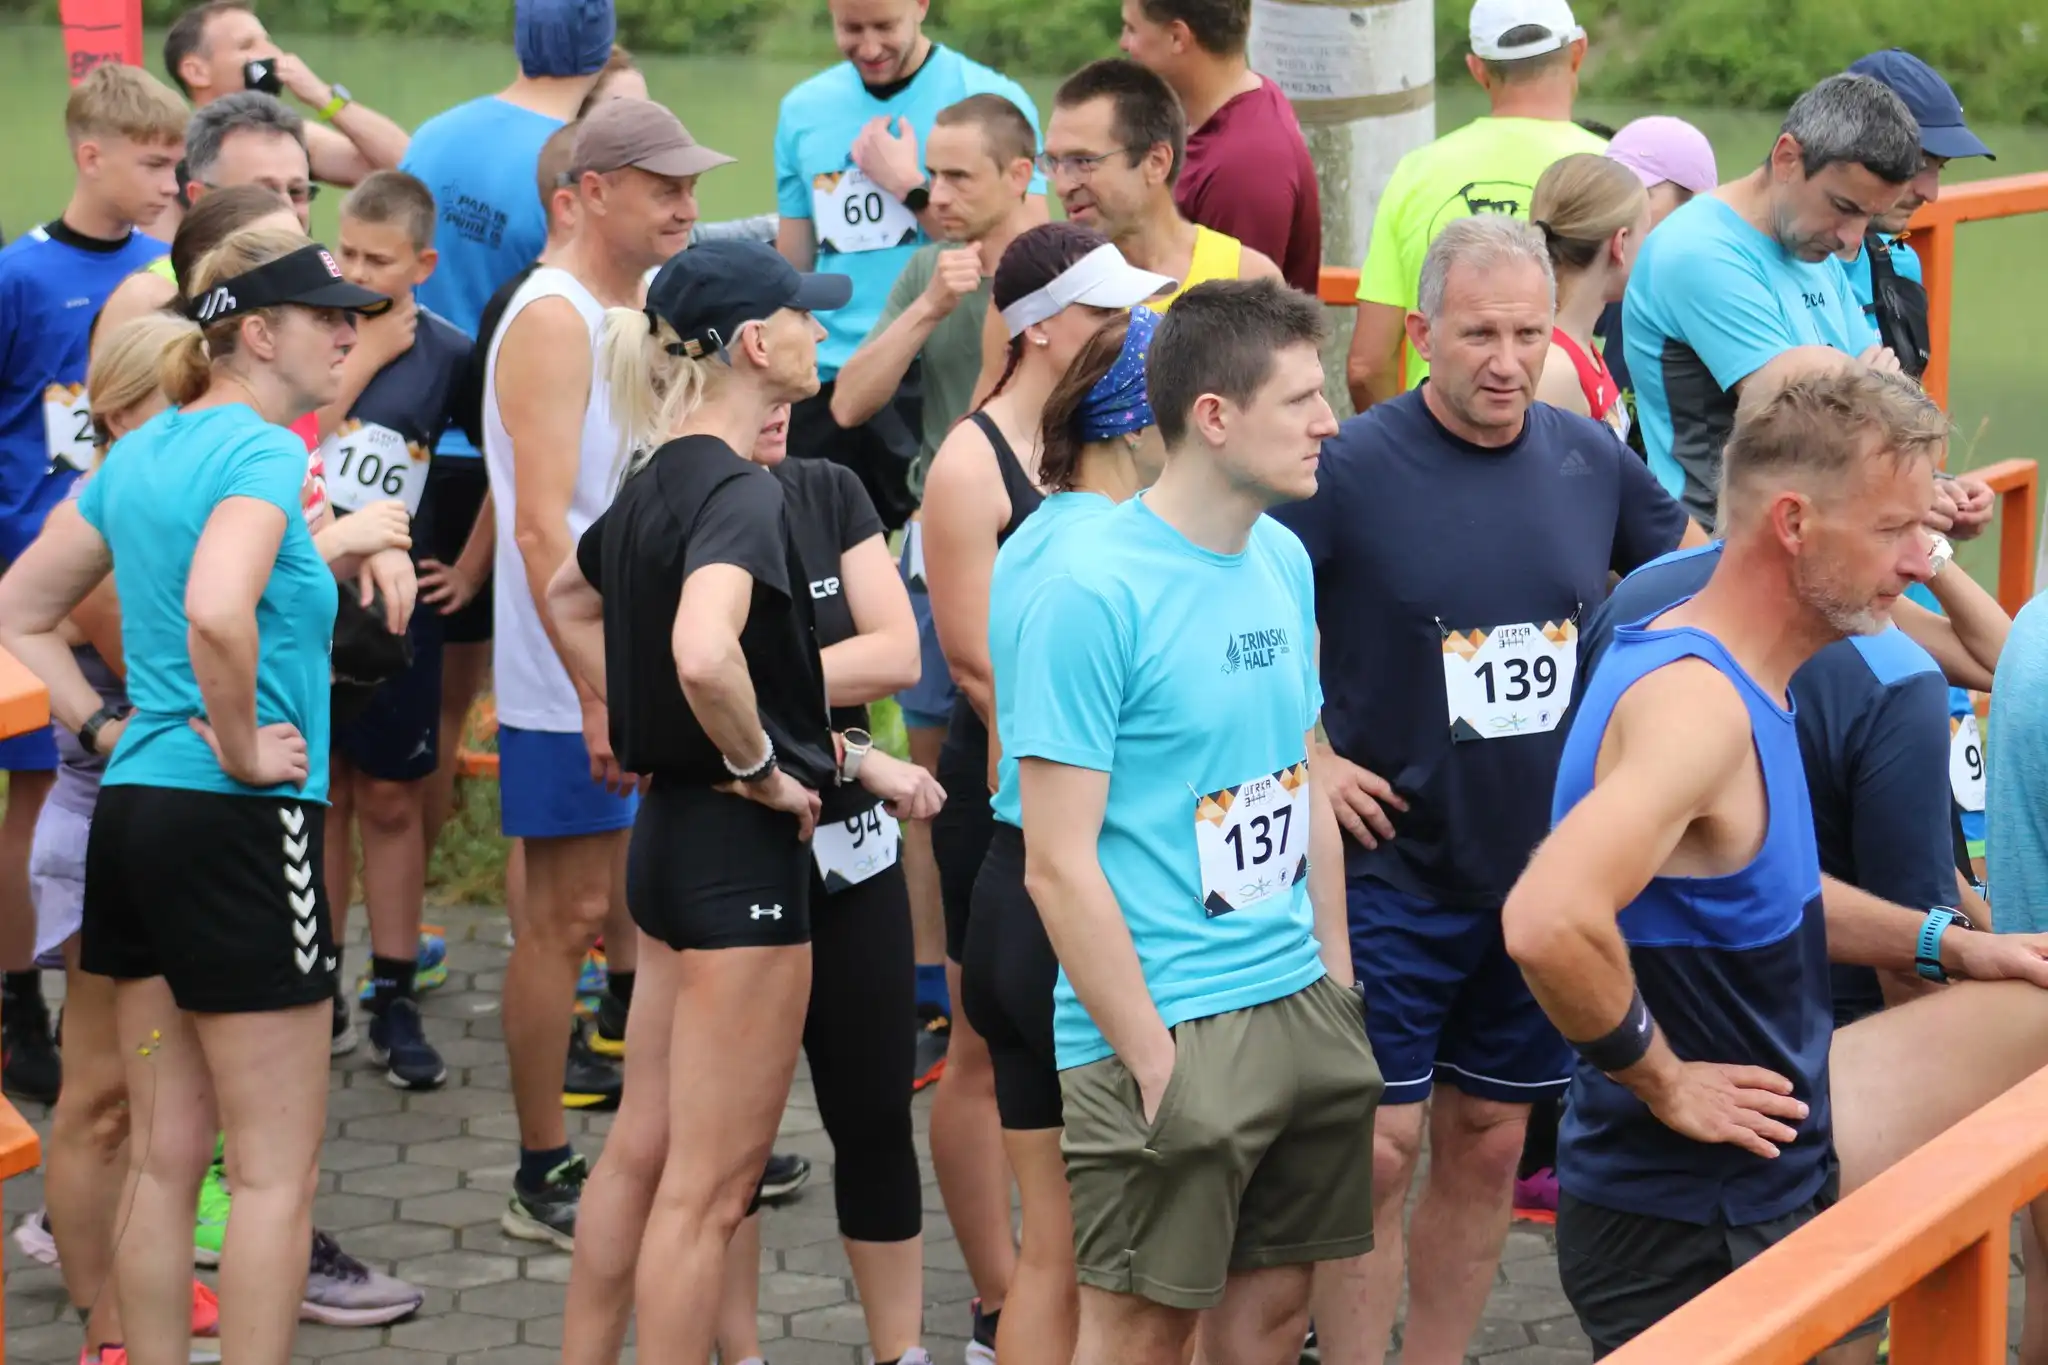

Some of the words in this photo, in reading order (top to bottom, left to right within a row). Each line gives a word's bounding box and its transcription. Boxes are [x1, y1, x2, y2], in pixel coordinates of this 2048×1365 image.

[844, 192, 882, 225] 60
[340, 447, 408, 495] 106
[1239, 628, 1288, 652] ZRINSKI
[1244, 648, 1275, 670] HALF
[1474, 655, 1557, 704] 139
[845, 808, 881, 849] 94
[1224, 804, 1292, 872] 137
